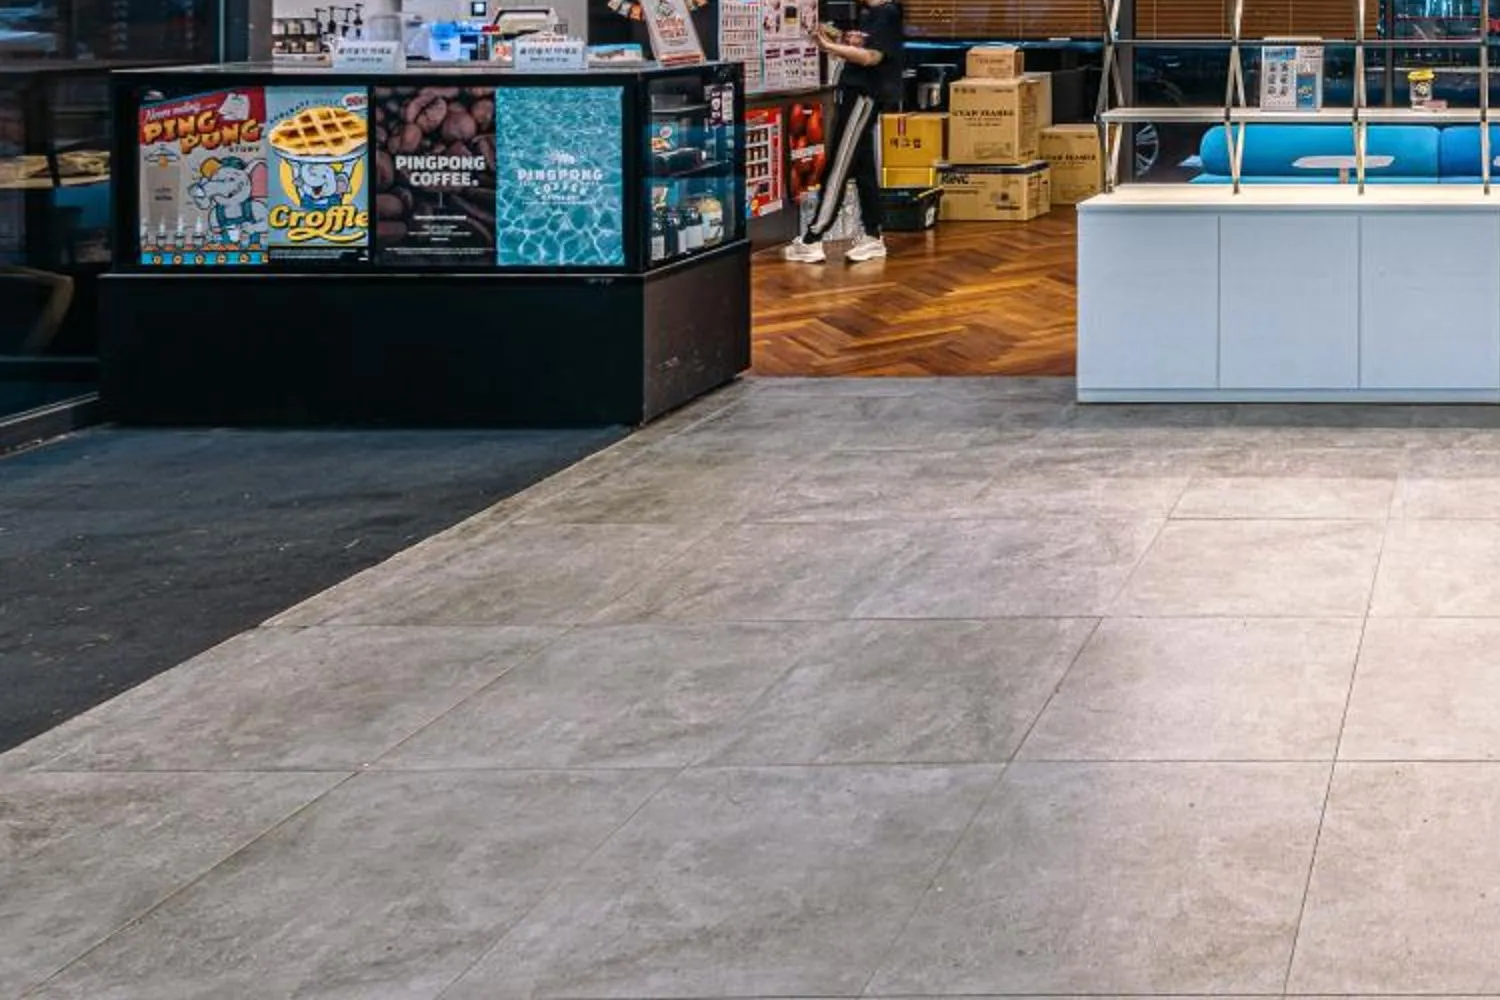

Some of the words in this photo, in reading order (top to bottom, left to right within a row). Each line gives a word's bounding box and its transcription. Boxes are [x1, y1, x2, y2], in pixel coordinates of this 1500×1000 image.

[143, 109, 219, 145] PING
[180, 119, 262, 154] PONG
[395, 156, 485, 170] PINGPONG
[268, 204, 369, 241] Croffle
